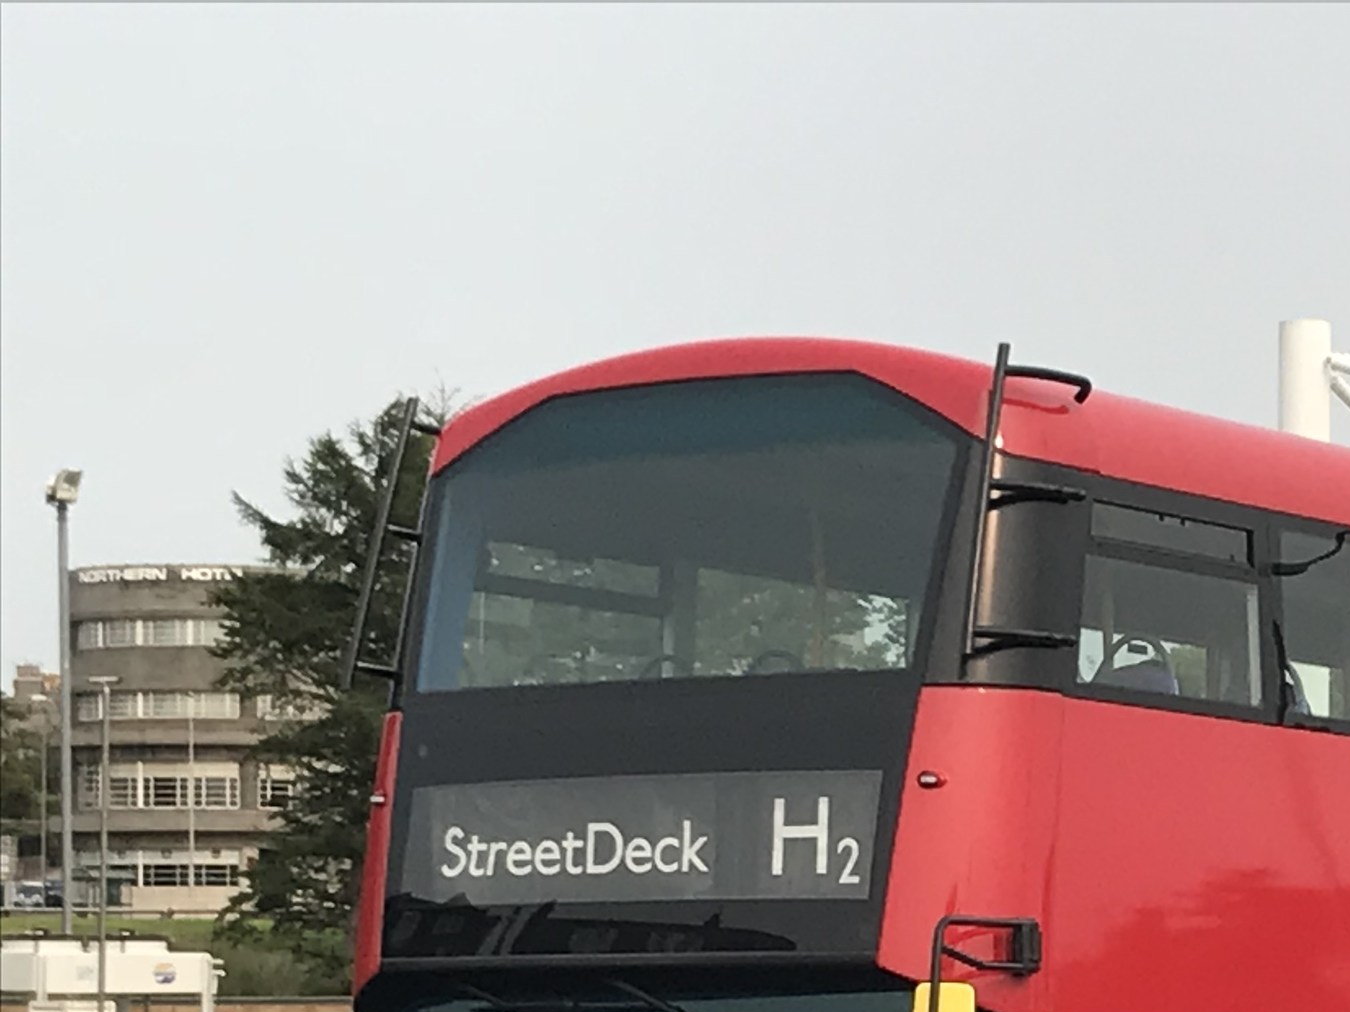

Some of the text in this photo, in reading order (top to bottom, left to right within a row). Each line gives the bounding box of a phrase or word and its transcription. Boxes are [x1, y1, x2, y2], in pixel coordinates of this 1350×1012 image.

[78, 567, 168, 583] NORTHERN
[441, 796, 861, 884] StreetDeck H2
